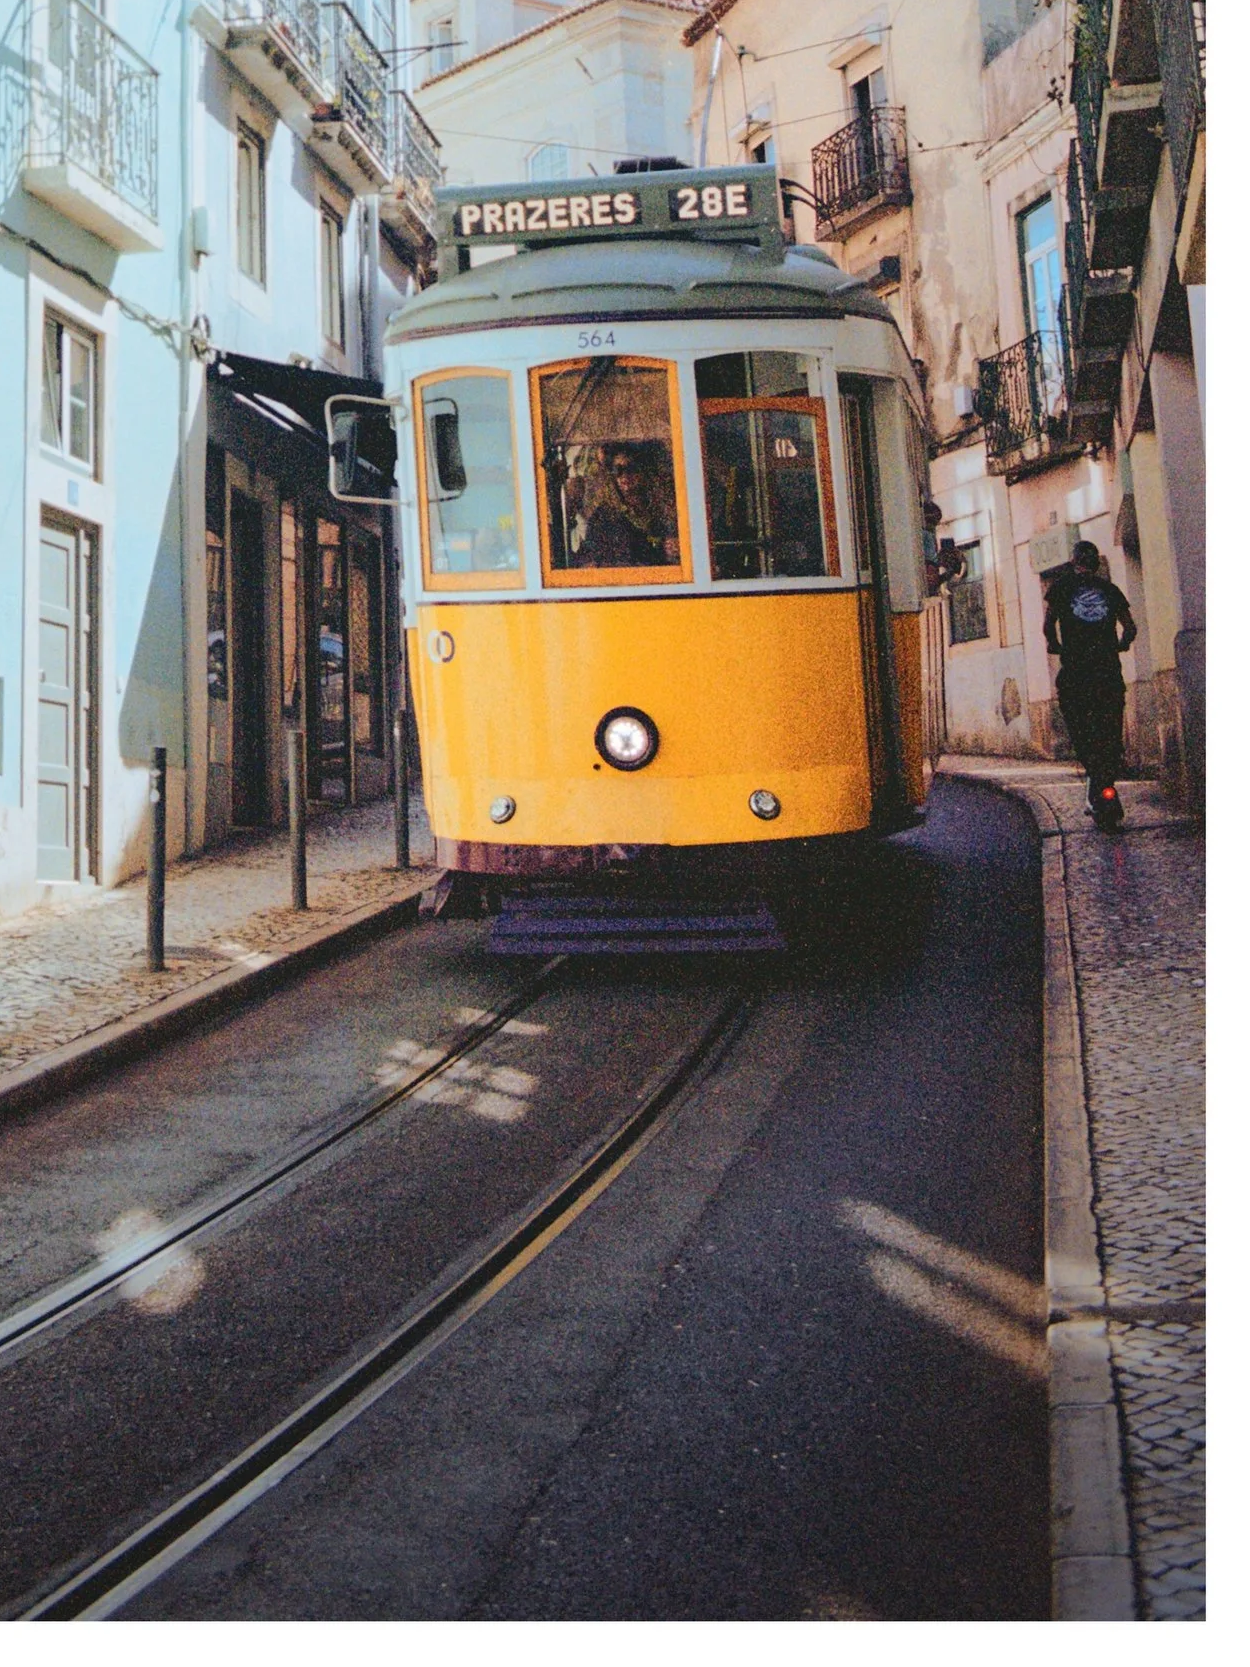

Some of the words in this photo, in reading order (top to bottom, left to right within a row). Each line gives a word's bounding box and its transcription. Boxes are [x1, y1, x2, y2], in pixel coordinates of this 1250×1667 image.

[461, 192, 636, 235] PRAZERES
[677, 185, 748, 219] 28E
[578, 330, 616, 349] 564
